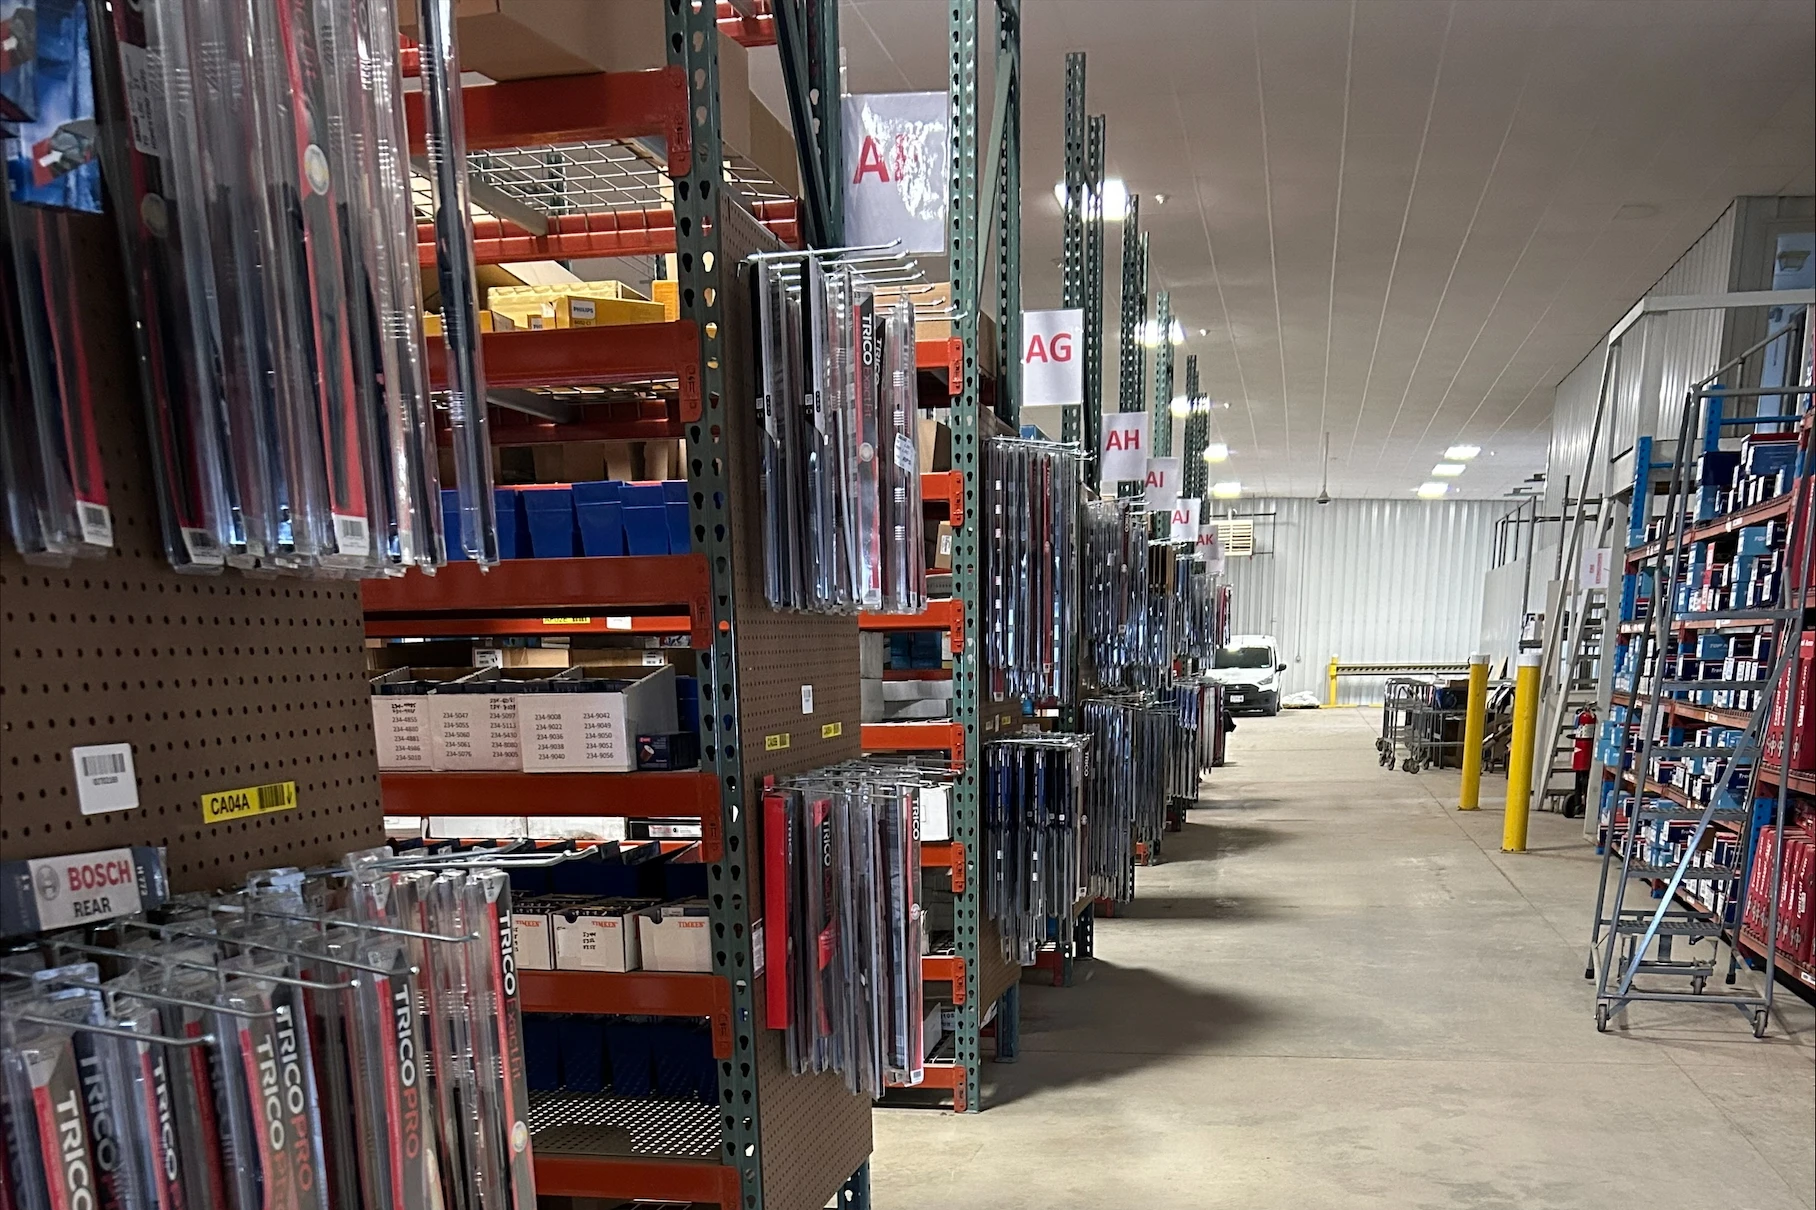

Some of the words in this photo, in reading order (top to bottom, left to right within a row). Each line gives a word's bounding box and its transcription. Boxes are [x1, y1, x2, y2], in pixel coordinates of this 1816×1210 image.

[573, 306, 594, 314] PHILIPS
[862, 313, 873, 366] TRICO
[1026, 332, 1072, 364] AG
[873, 338, 883, 387] TRICO
[1105, 429, 1140, 451] AH
[1144, 471, 1164, 488] AI
[1172, 510, 1190, 524] AJ
[1196, 534, 1214, 546] AK
[210, 793, 250, 816] CA04A
[912, 797, 920, 840] TRICO
[822, 818, 832, 867] TRICO
[67, 859, 133, 892] BOSCH
[73, 896, 112, 918] REAR
[515, 920, 542, 928] TIMKEN
[591, 920, 618, 928] TIMKEN
[499, 910, 517, 997] TRICO
[394, 983, 416, 1087] TRICO
[257, 1033, 285, 1151] TRICO
[275, 1003, 304, 1115] TRICO
[290, 1115, 313, 1192] PRO
[79, 1055, 118, 1173] TRICO
[153, 1056, 179, 1182] TRICO
[403, 1088, 420, 1160] PRO
